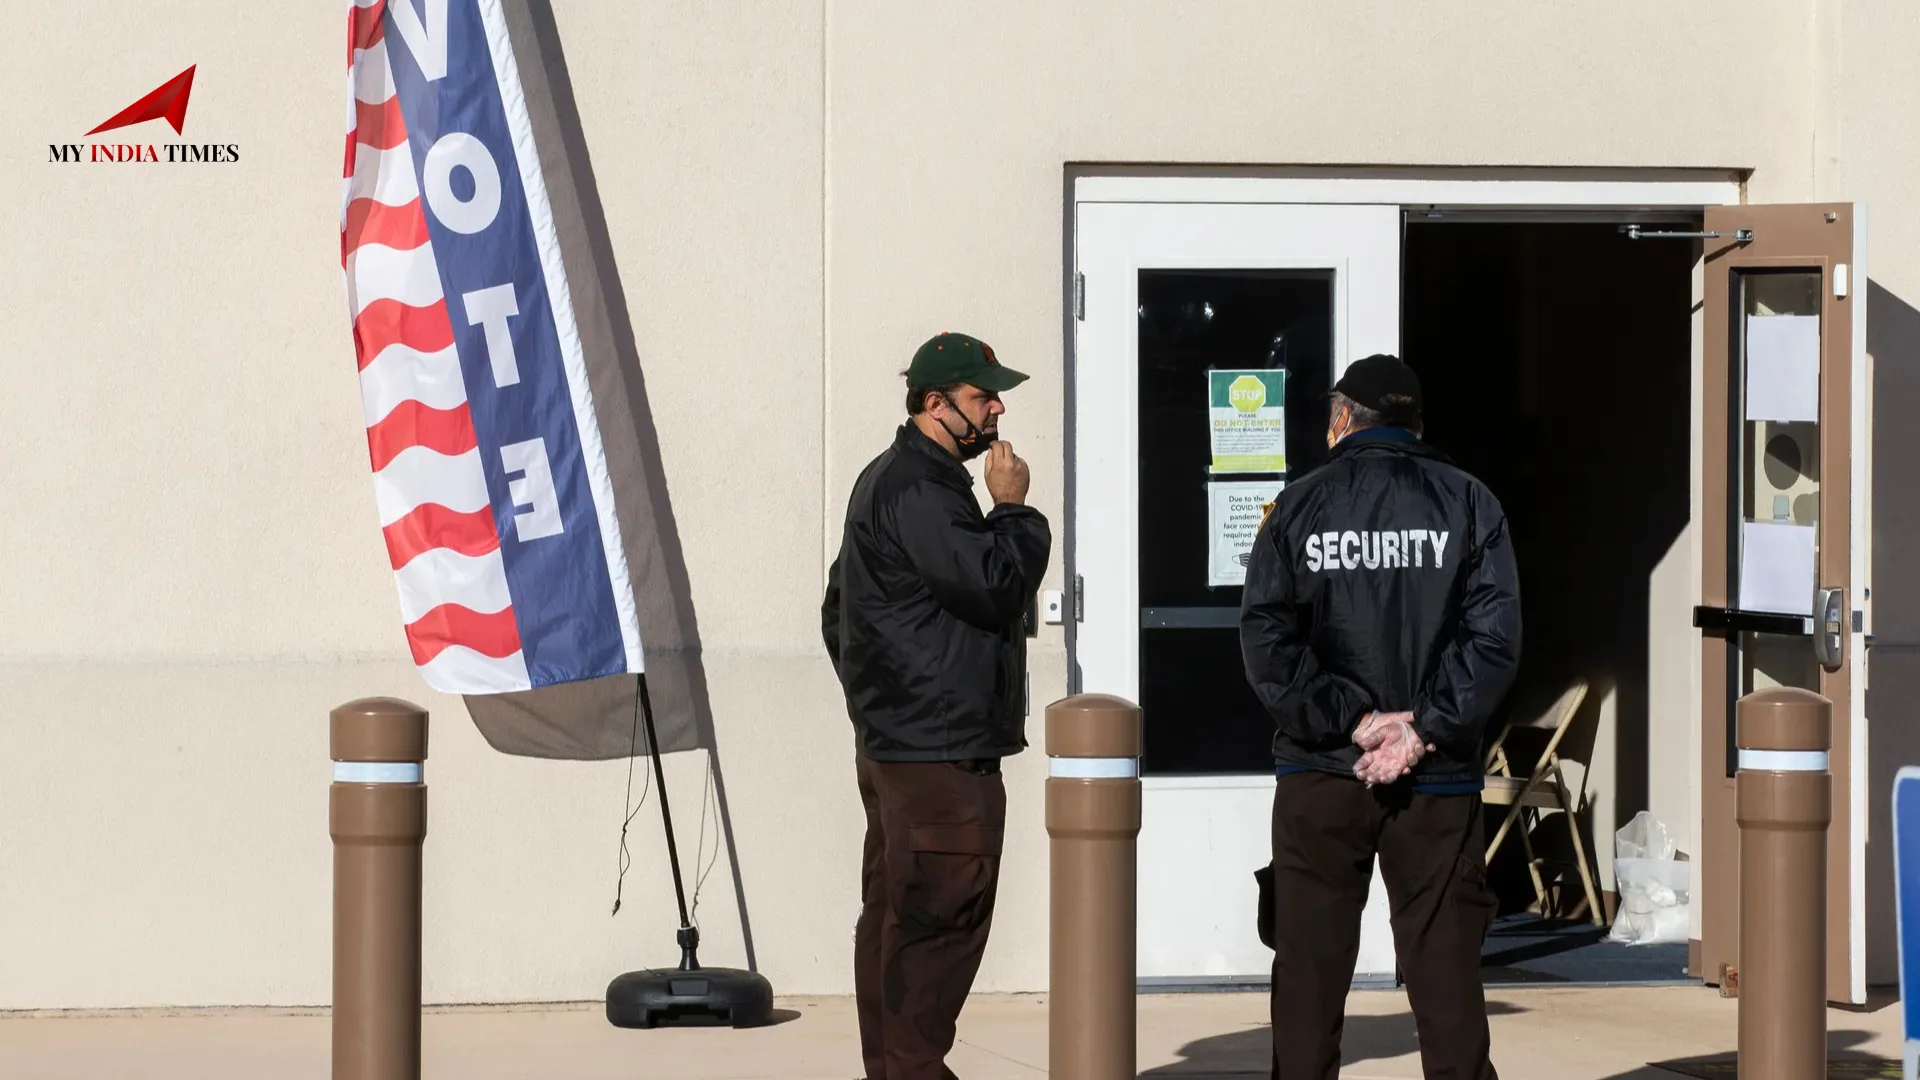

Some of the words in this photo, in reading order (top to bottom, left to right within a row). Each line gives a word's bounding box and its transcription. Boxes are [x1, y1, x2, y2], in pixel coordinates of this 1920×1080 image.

[1232, 389, 1263, 401] STOP
[1214, 419, 1227, 427] DO
[1229, 419, 1249, 427] NOT
[1251, 418, 1281, 427] ENTER
[1228, 495, 1243, 503] Due
[1253, 494, 1265, 503] the
[1229, 513, 1263, 522] pandemic
[1223, 522, 1238, 530] face
[1223, 532, 1252, 540] required
[1233, 540, 1253, 548] indoo
[1305, 529, 1450, 573] SECURITY
